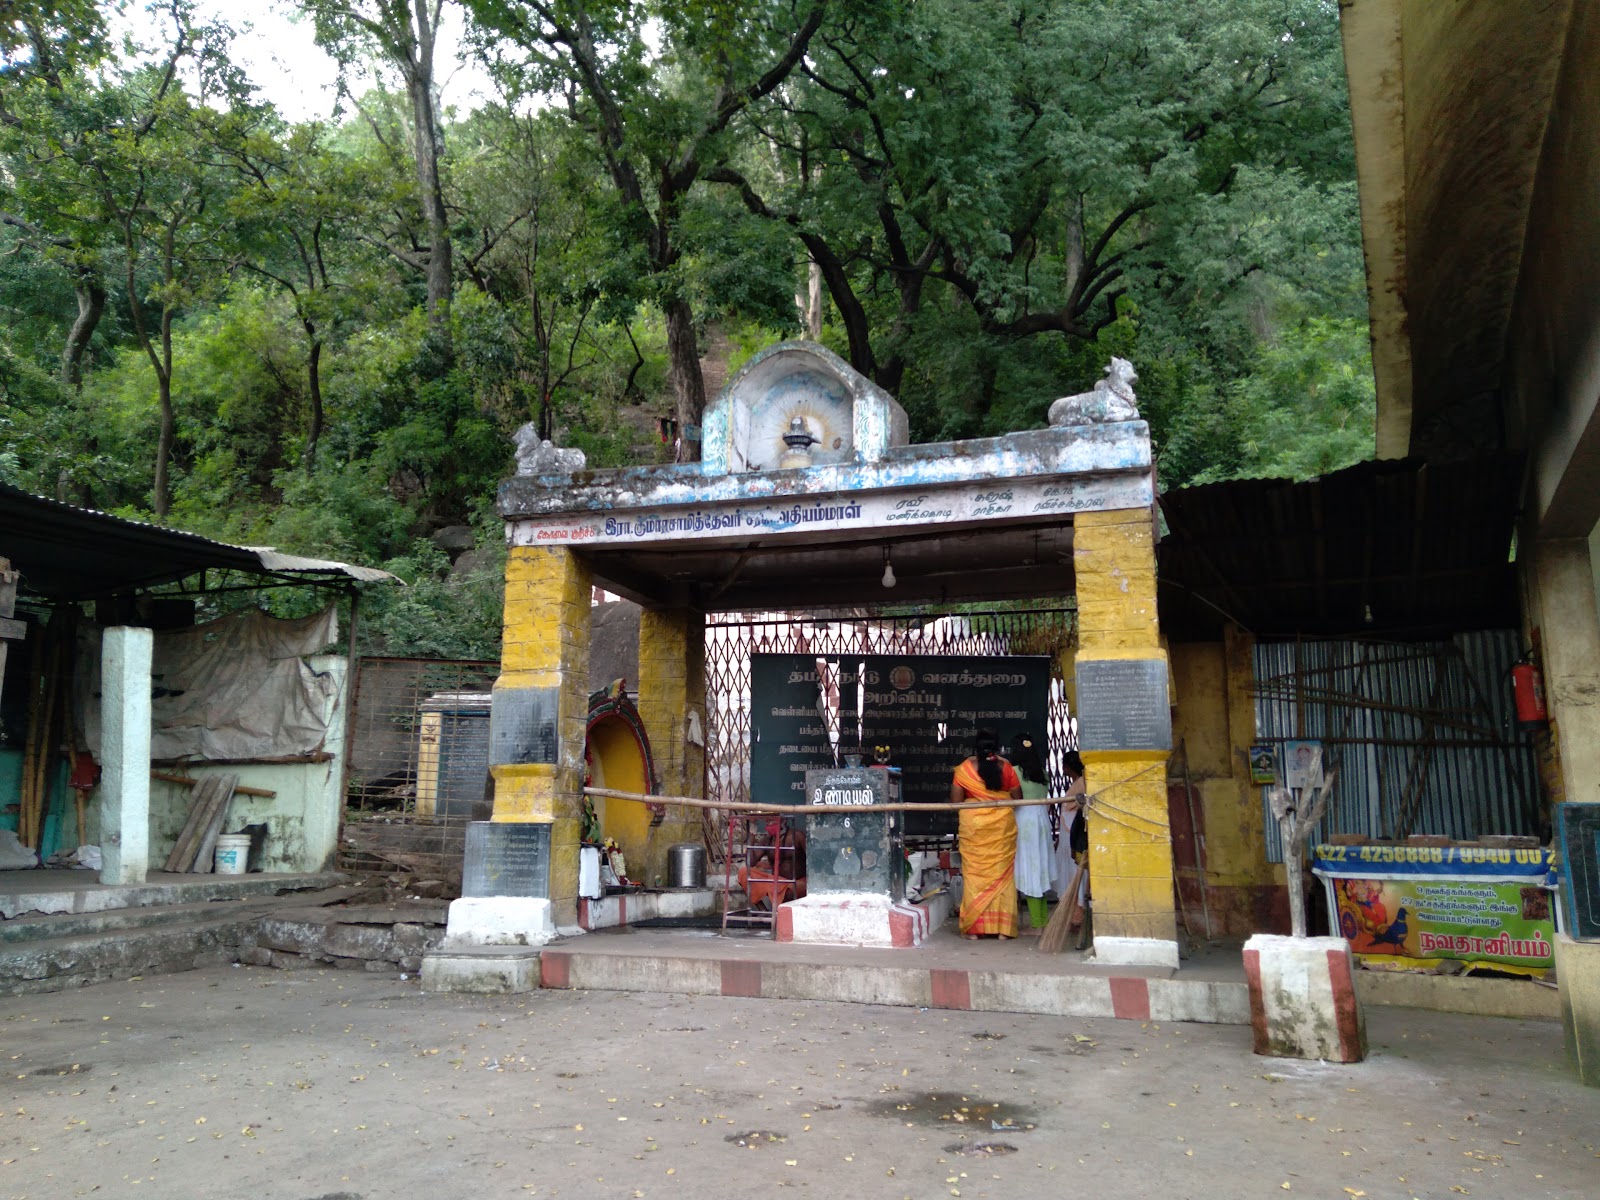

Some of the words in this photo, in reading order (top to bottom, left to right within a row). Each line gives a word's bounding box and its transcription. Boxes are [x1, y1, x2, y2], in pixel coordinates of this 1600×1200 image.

[895, 495, 928, 510] ரவி
[922, 668, 1027, 688] வனத்துறை
[864, 689, 942, 708] அறிவிப்பு
[950, 709, 957, 718] 7
[978, 710, 1003, 719] மலை
[1004, 710, 1028, 719] வரை
[812, 784, 874, 806] உண்டியல்
[844, 817, 851, 828] 6
[1489, 901, 1518, 914] இங்கு
[1420, 930, 1551, 958] நவதானியம்
